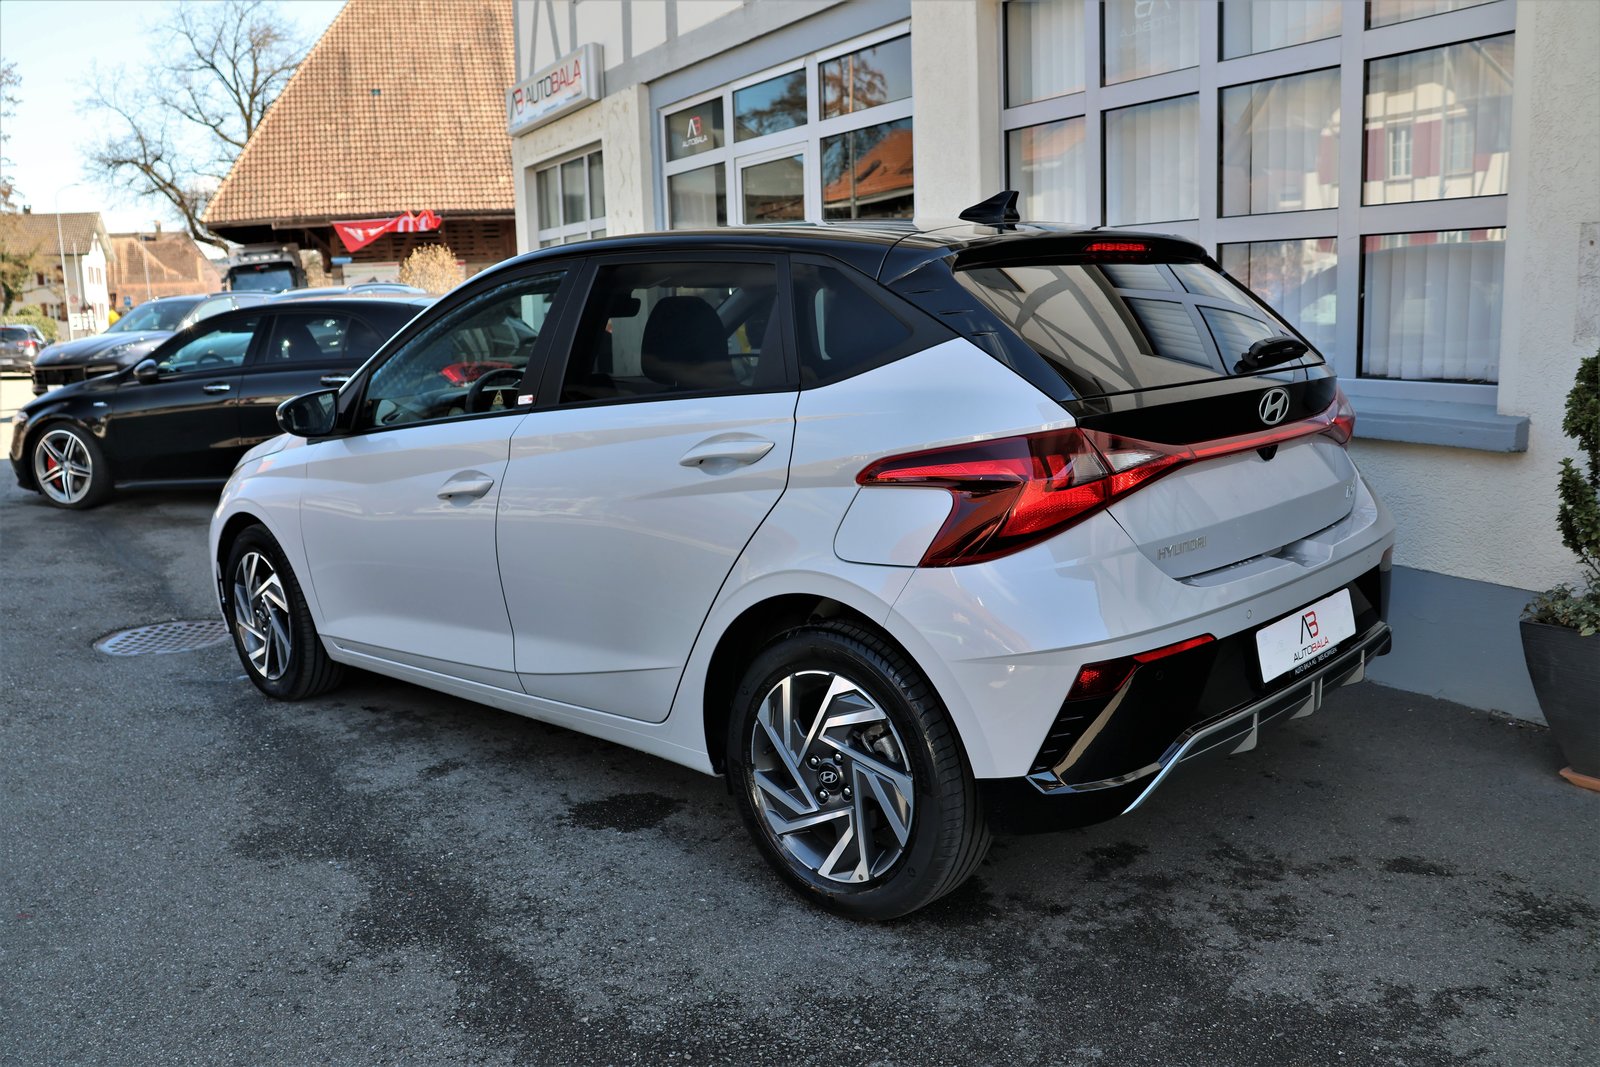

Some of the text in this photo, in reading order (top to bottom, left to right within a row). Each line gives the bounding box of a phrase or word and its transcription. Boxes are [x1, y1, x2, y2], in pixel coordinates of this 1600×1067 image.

[526, 59, 581, 107] AUTOBALA
[682, 134, 708, 147] AUTOBALA
[1156, 535, 1206, 560] HYUNDAI
[1293, 636, 1329, 662] AUTOBALA
